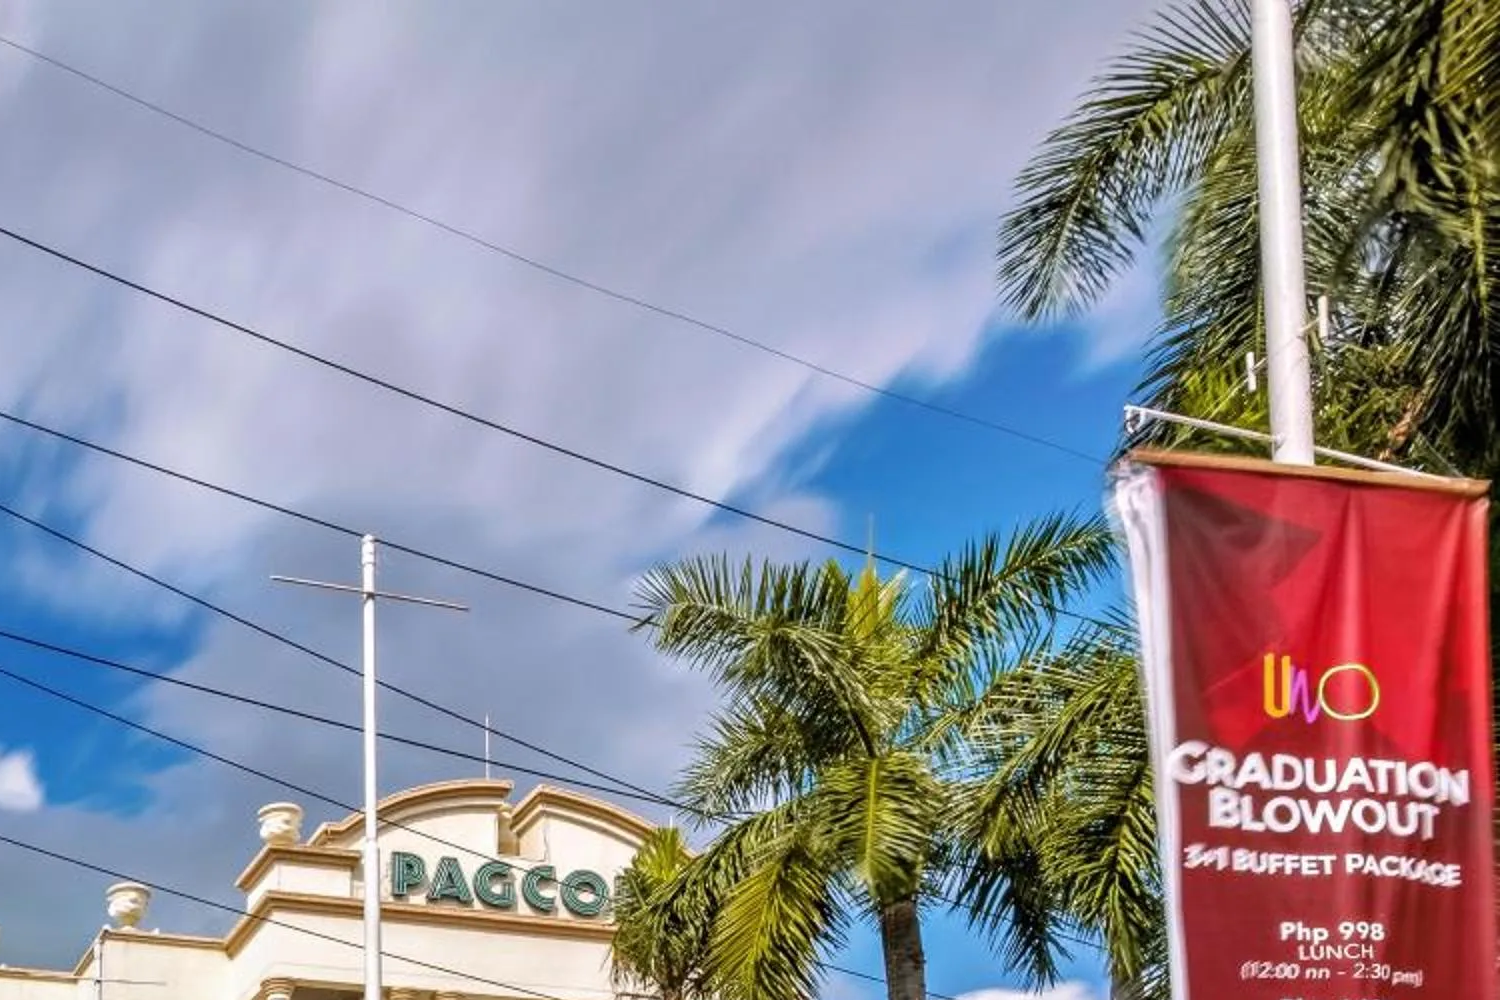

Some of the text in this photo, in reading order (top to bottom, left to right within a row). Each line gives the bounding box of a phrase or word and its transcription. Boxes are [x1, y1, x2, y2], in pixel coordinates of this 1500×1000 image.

[1263, 653, 1380, 723] UNO
[1166, 740, 1470, 806] GRADUATION
[1208, 787, 1440, 840] BLOWOUT
[391, 851, 622, 917] PAGCO
[1231, 848, 1337, 876] BUFFET
[1345, 852, 1462, 887] PACKAGE
[1280, 922, 1386, 945] Php 998
[1297, 944, 1375, 961] LUNCH
[1305, 967, 1331, 980] nn
[1353, 962, 1391, 981] 2:30
[1392, 969, 1423, 988] pm)
